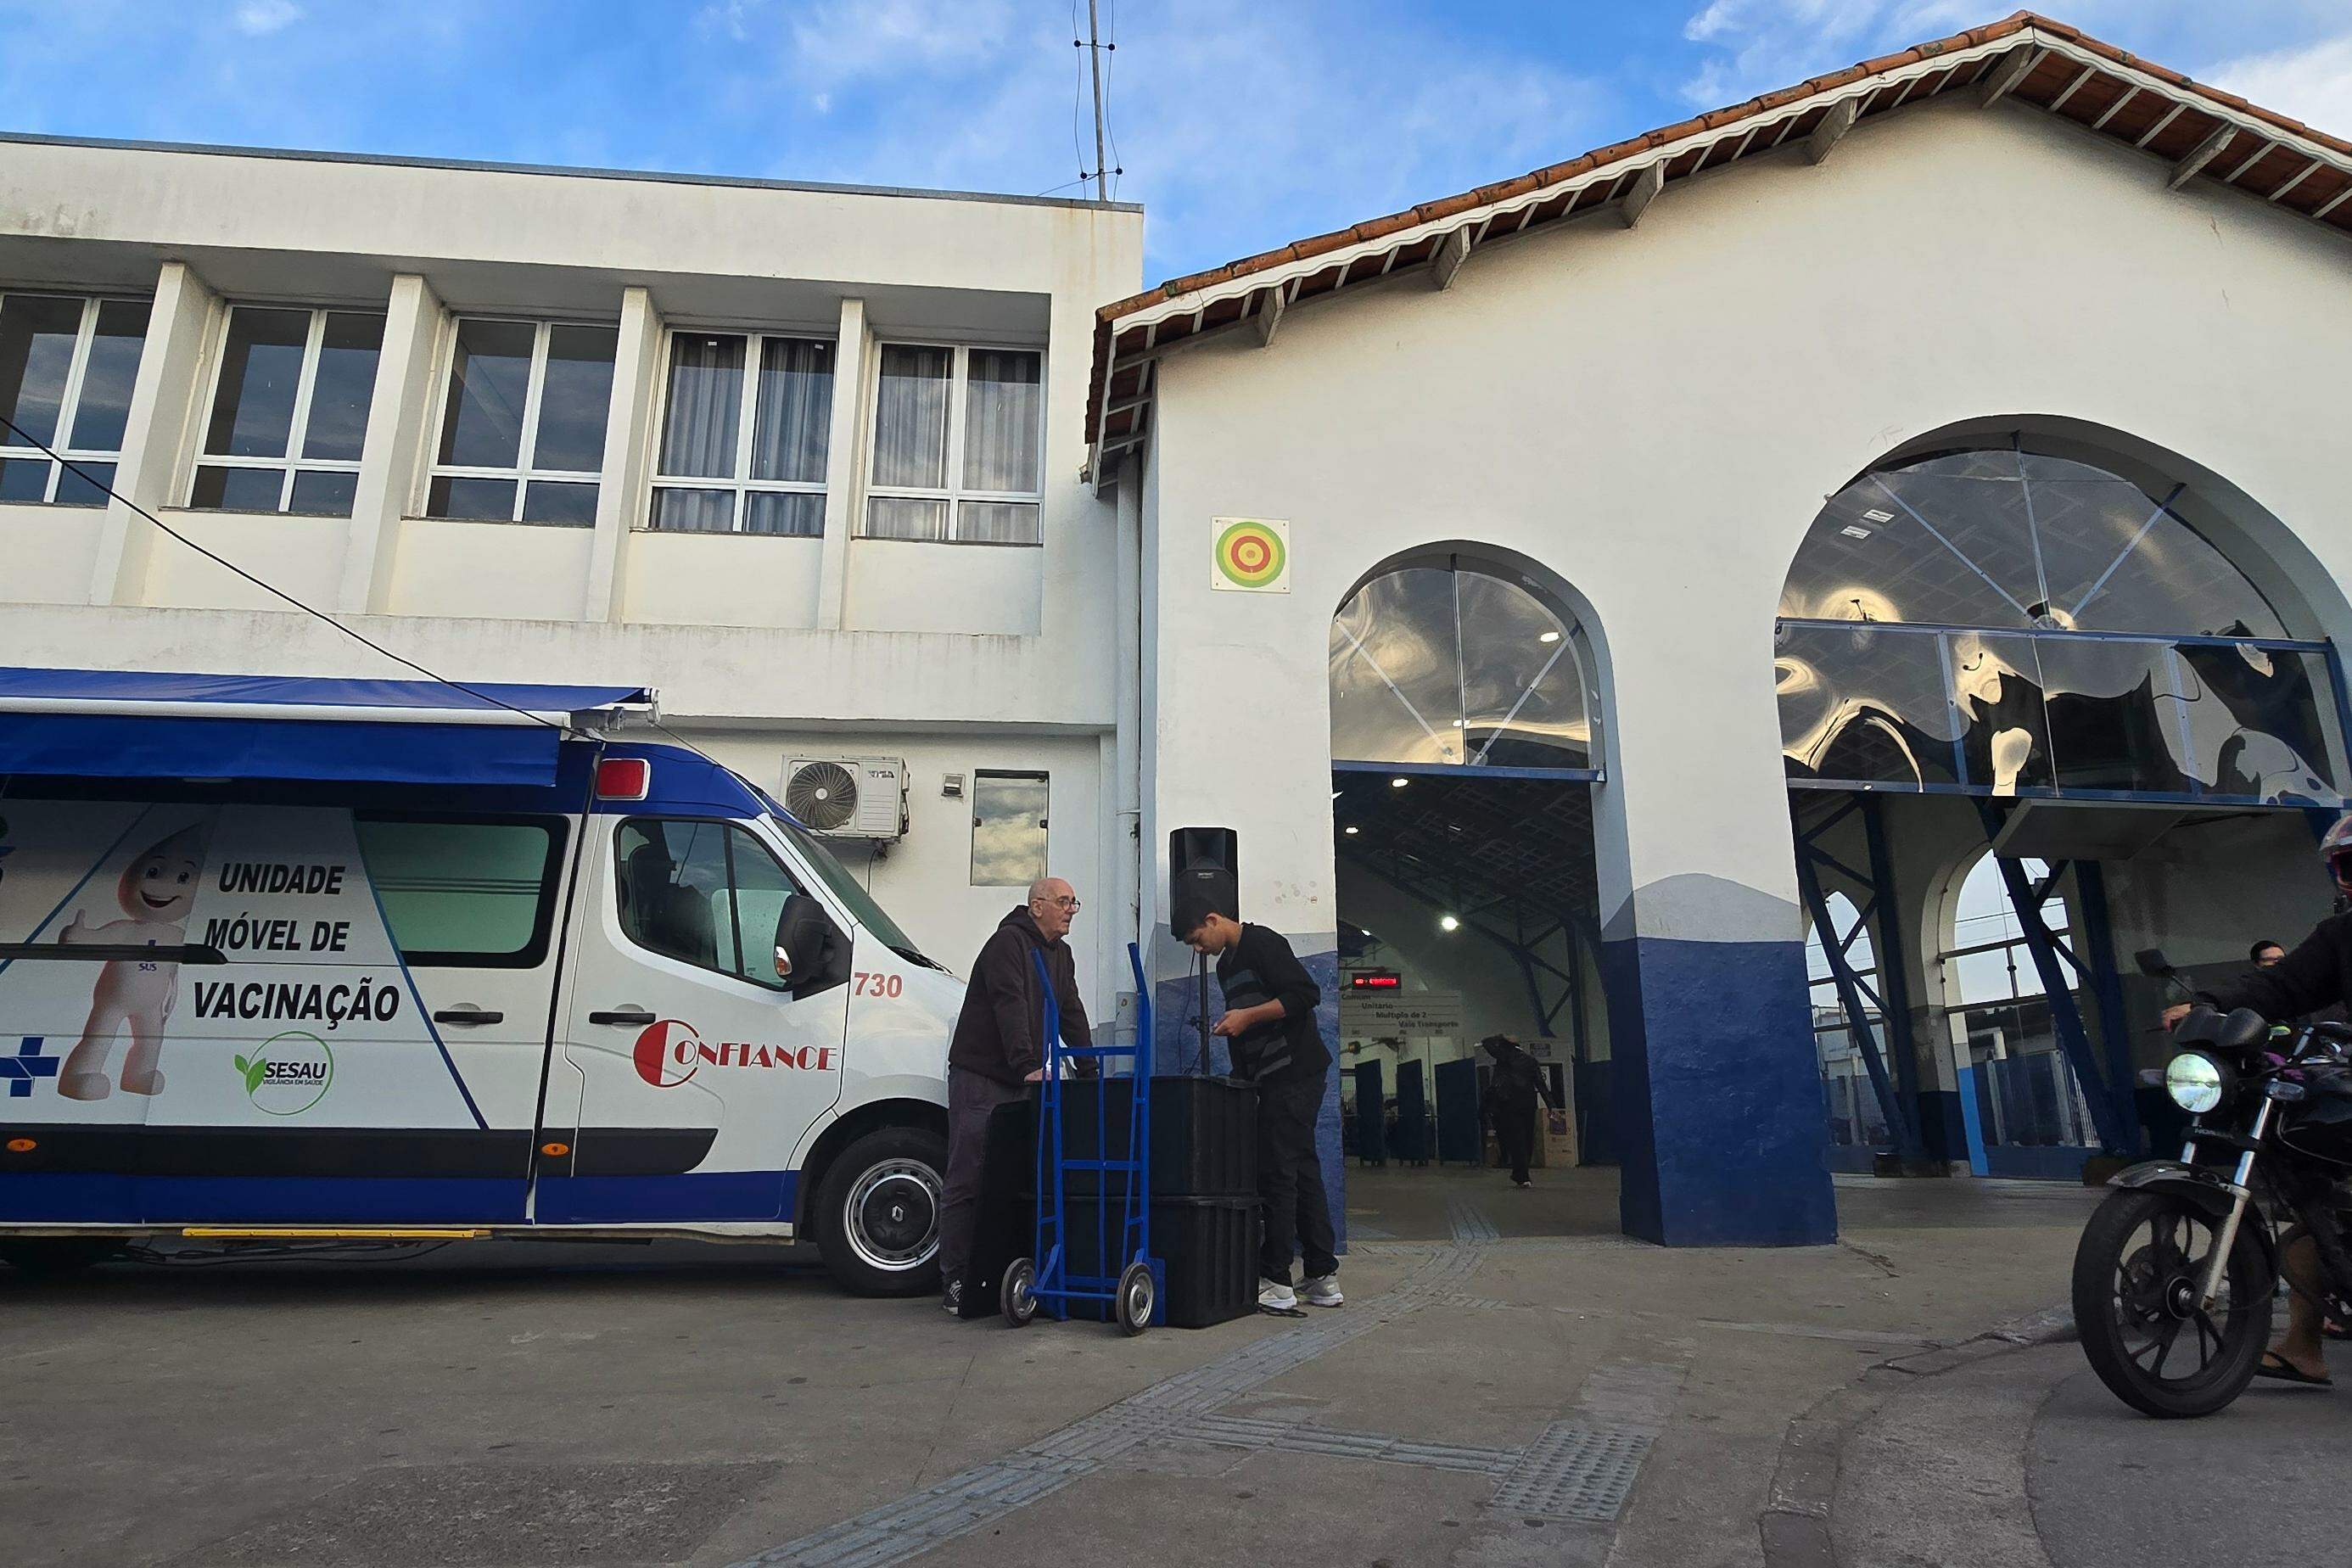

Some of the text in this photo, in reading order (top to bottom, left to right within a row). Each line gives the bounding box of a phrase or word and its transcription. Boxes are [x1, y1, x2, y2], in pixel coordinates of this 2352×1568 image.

[218, 862, 346, 895] UNIDADE
[203, 910, 350, 952] MÓVEL DE
[138, 962, 157, 972] SUS
[854, 972, 904, 998] 730
[193, 977, 400, 1031] VACINAÇÃO
[264, 1061, 327, 1079] SESAU
[633, 1019, 837, 1088] CONFIANCE
